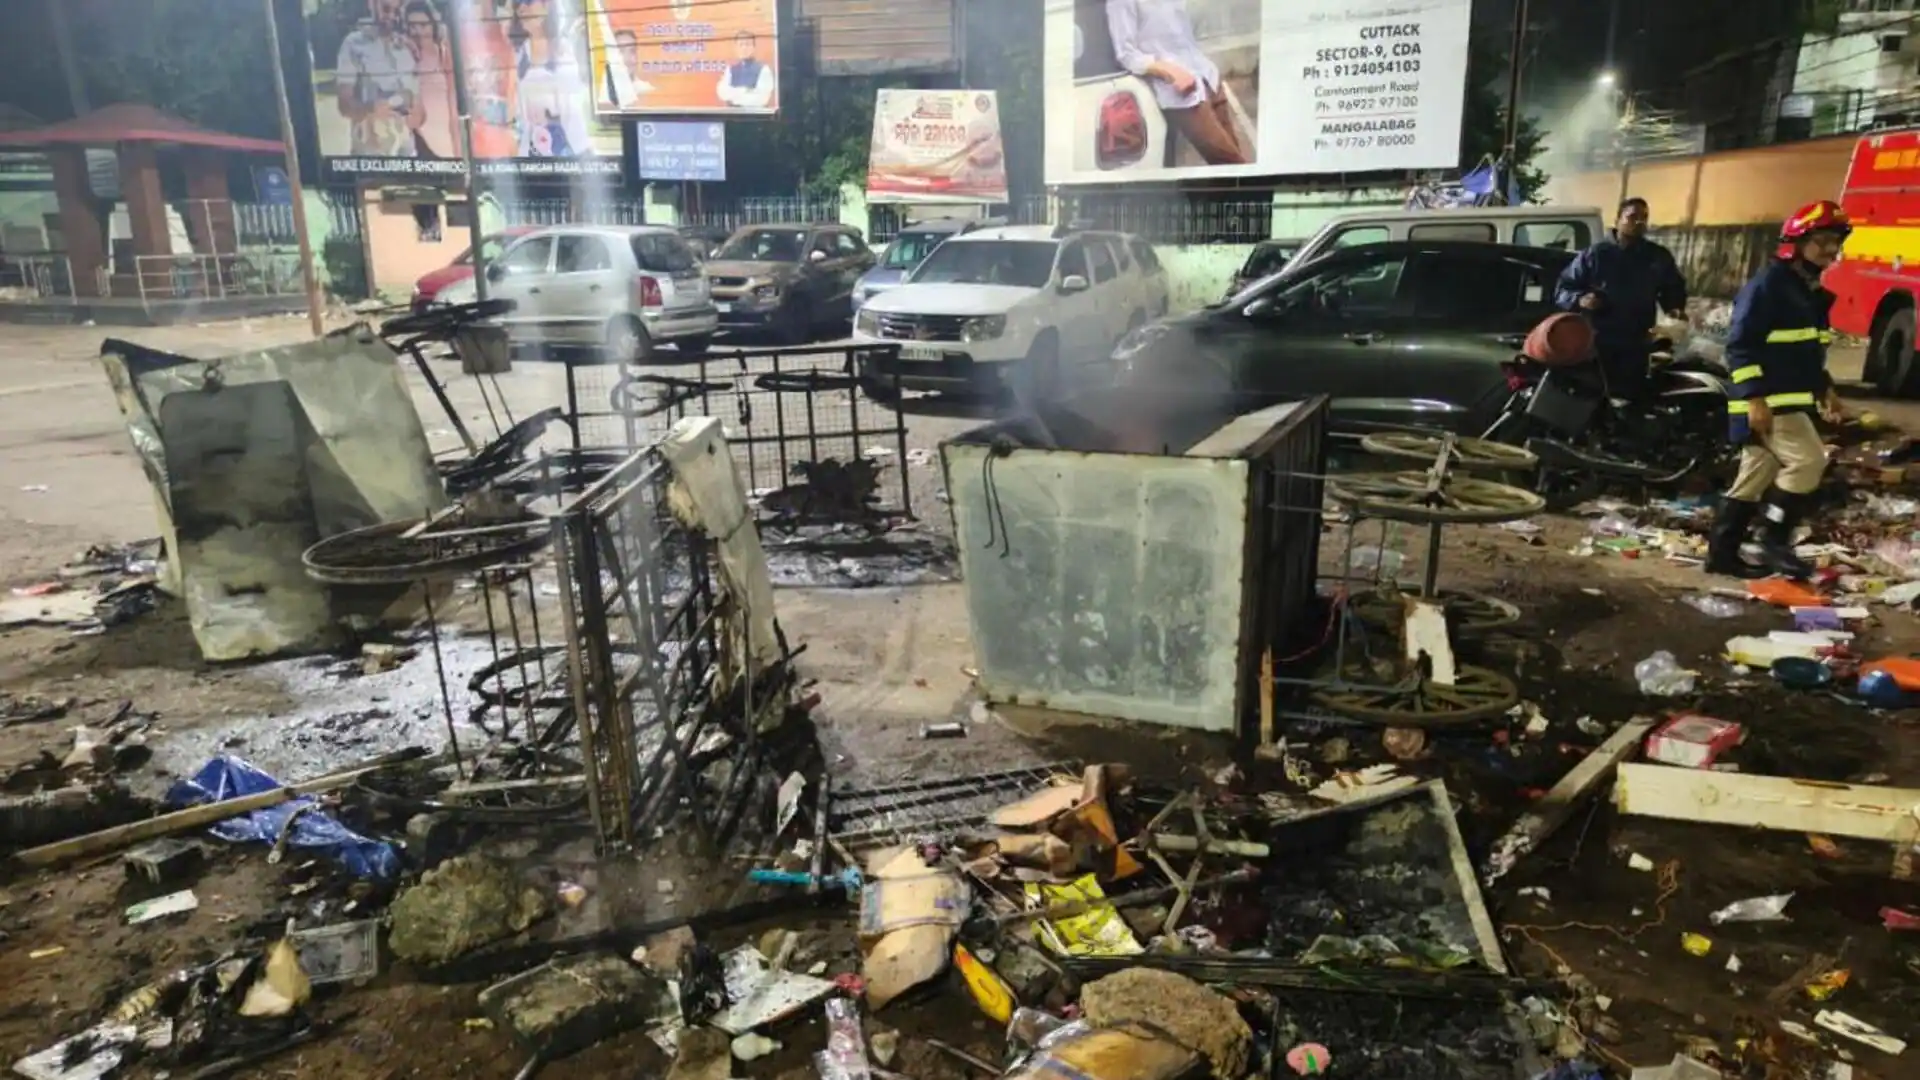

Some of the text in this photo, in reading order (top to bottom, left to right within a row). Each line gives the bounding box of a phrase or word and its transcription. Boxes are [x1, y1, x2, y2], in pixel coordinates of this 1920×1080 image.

[1360, 24, 1420, 39] CUTTACK
[1316, 43, 1421, 61] SECTOR-9, CDA
[1303, 65, 1320, 79] Ph
[1334, 60, 1420, 77] 9124054103
[1390, 80, 1419, 92] Road
[1321, 119, 1416, 134] MANGALABAG
[332, 158, 357, 171] DUKE
[360, 158, 412, 172] EXCLUSIVE
